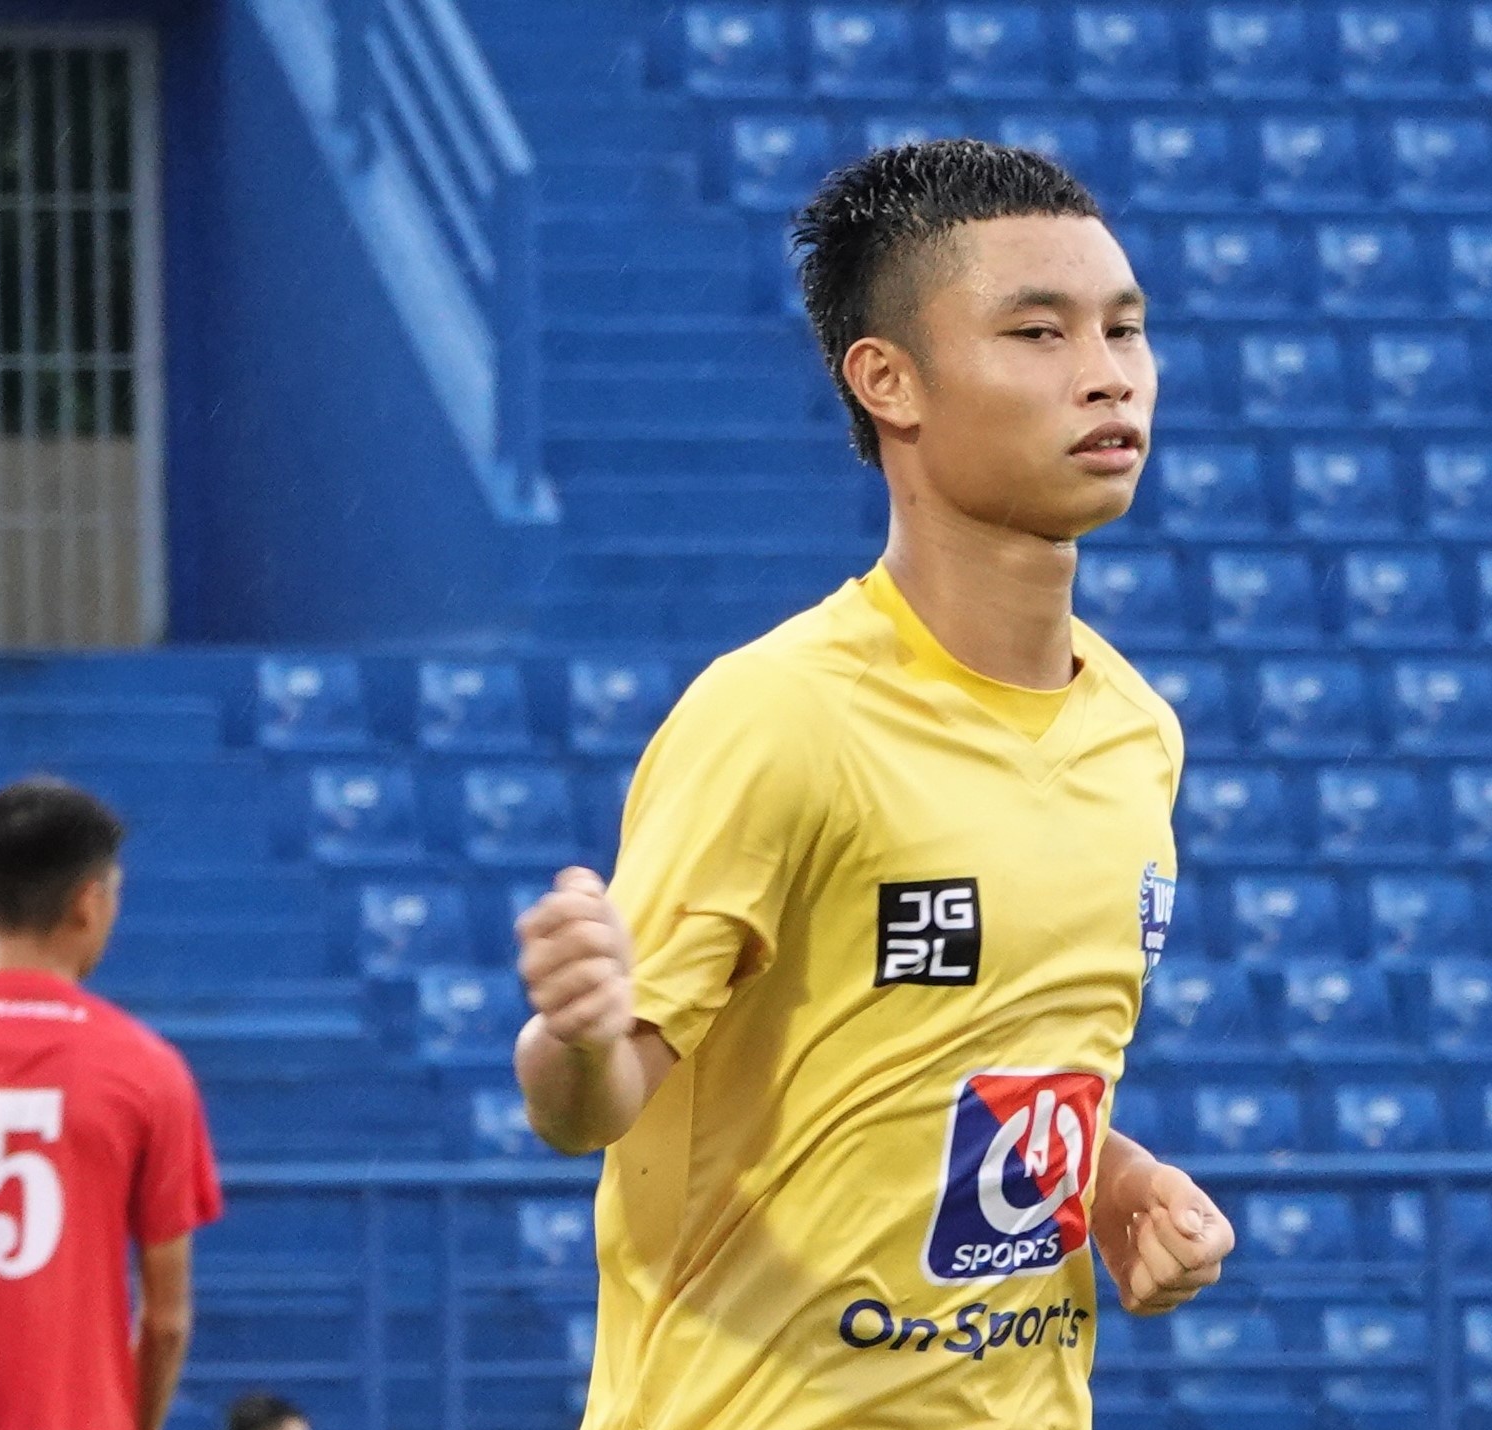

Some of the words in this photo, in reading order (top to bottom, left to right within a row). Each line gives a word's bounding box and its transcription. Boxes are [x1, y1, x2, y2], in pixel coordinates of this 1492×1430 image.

[886, 886, 975, 932] JG
[882, 937, 972, 980] BL
[839, 1298, 939, 1353] On
[943, 1297, 1090, 1361] Sports
